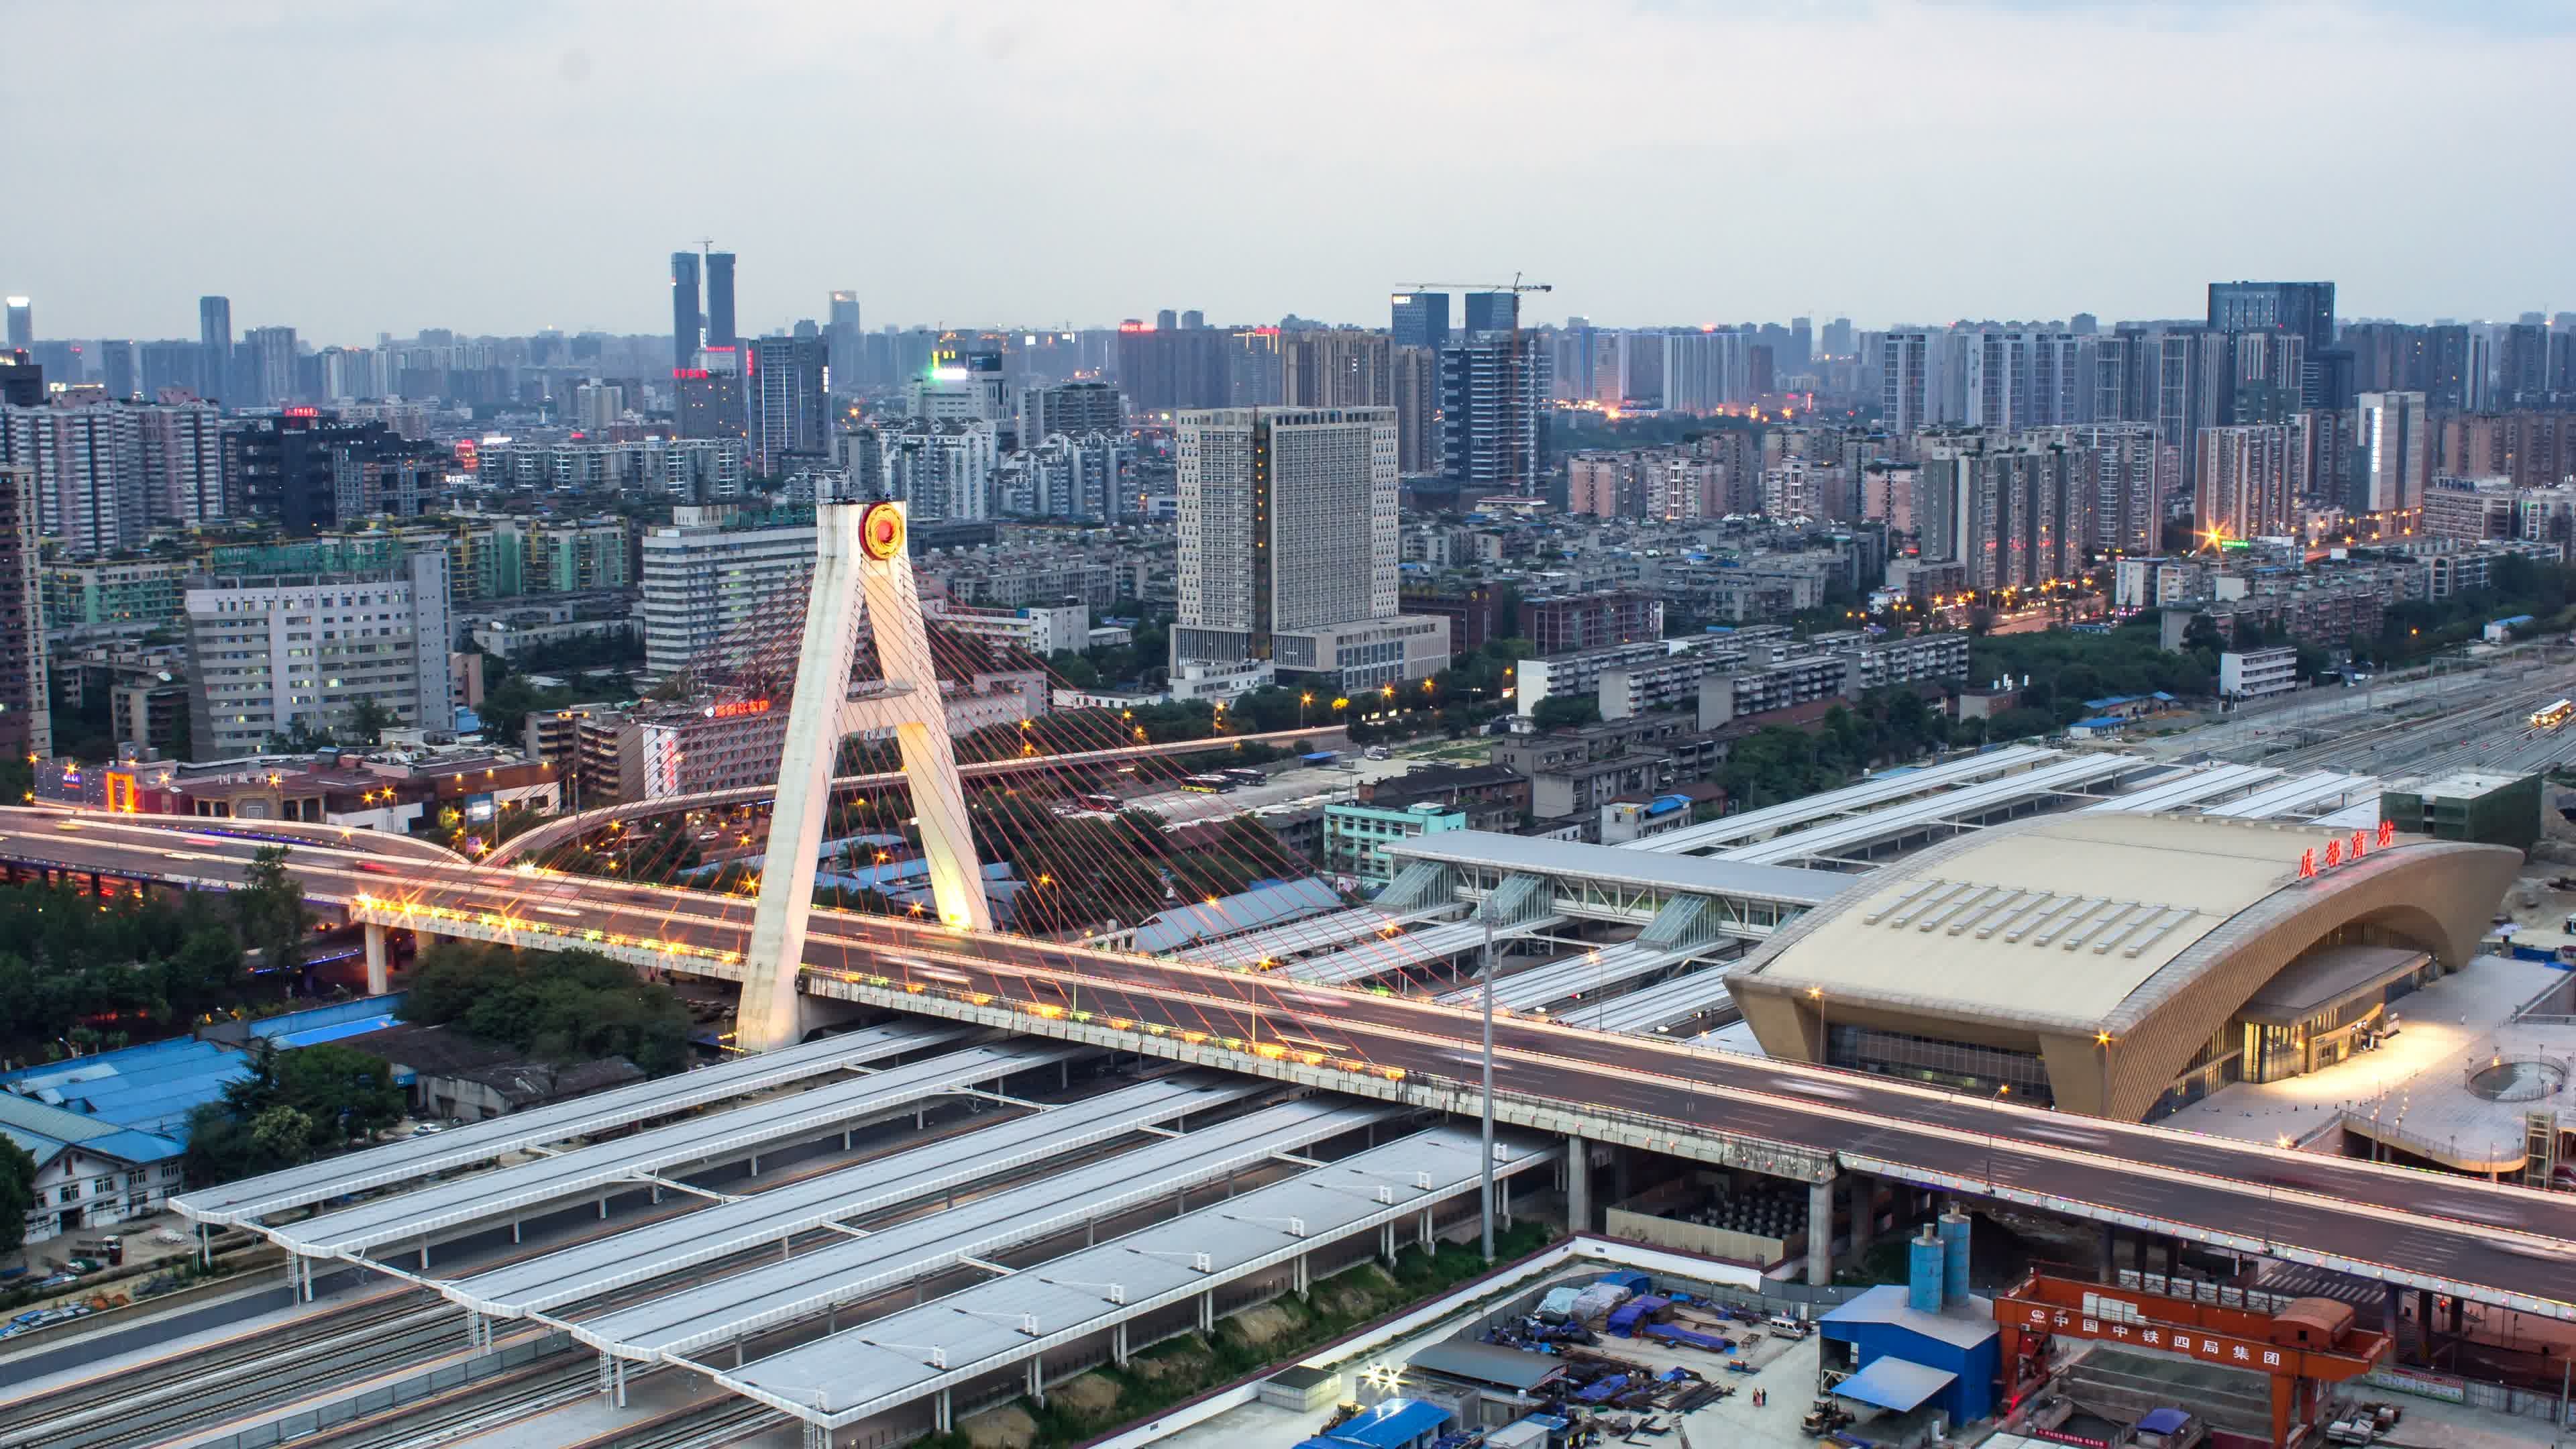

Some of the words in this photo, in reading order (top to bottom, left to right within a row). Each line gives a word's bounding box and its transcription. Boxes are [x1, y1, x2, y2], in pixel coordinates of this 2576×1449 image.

[2299, 820, 2394, 878] 成都南站
[2053, 1314, 2280, 1366] 中国中铁四局集团
